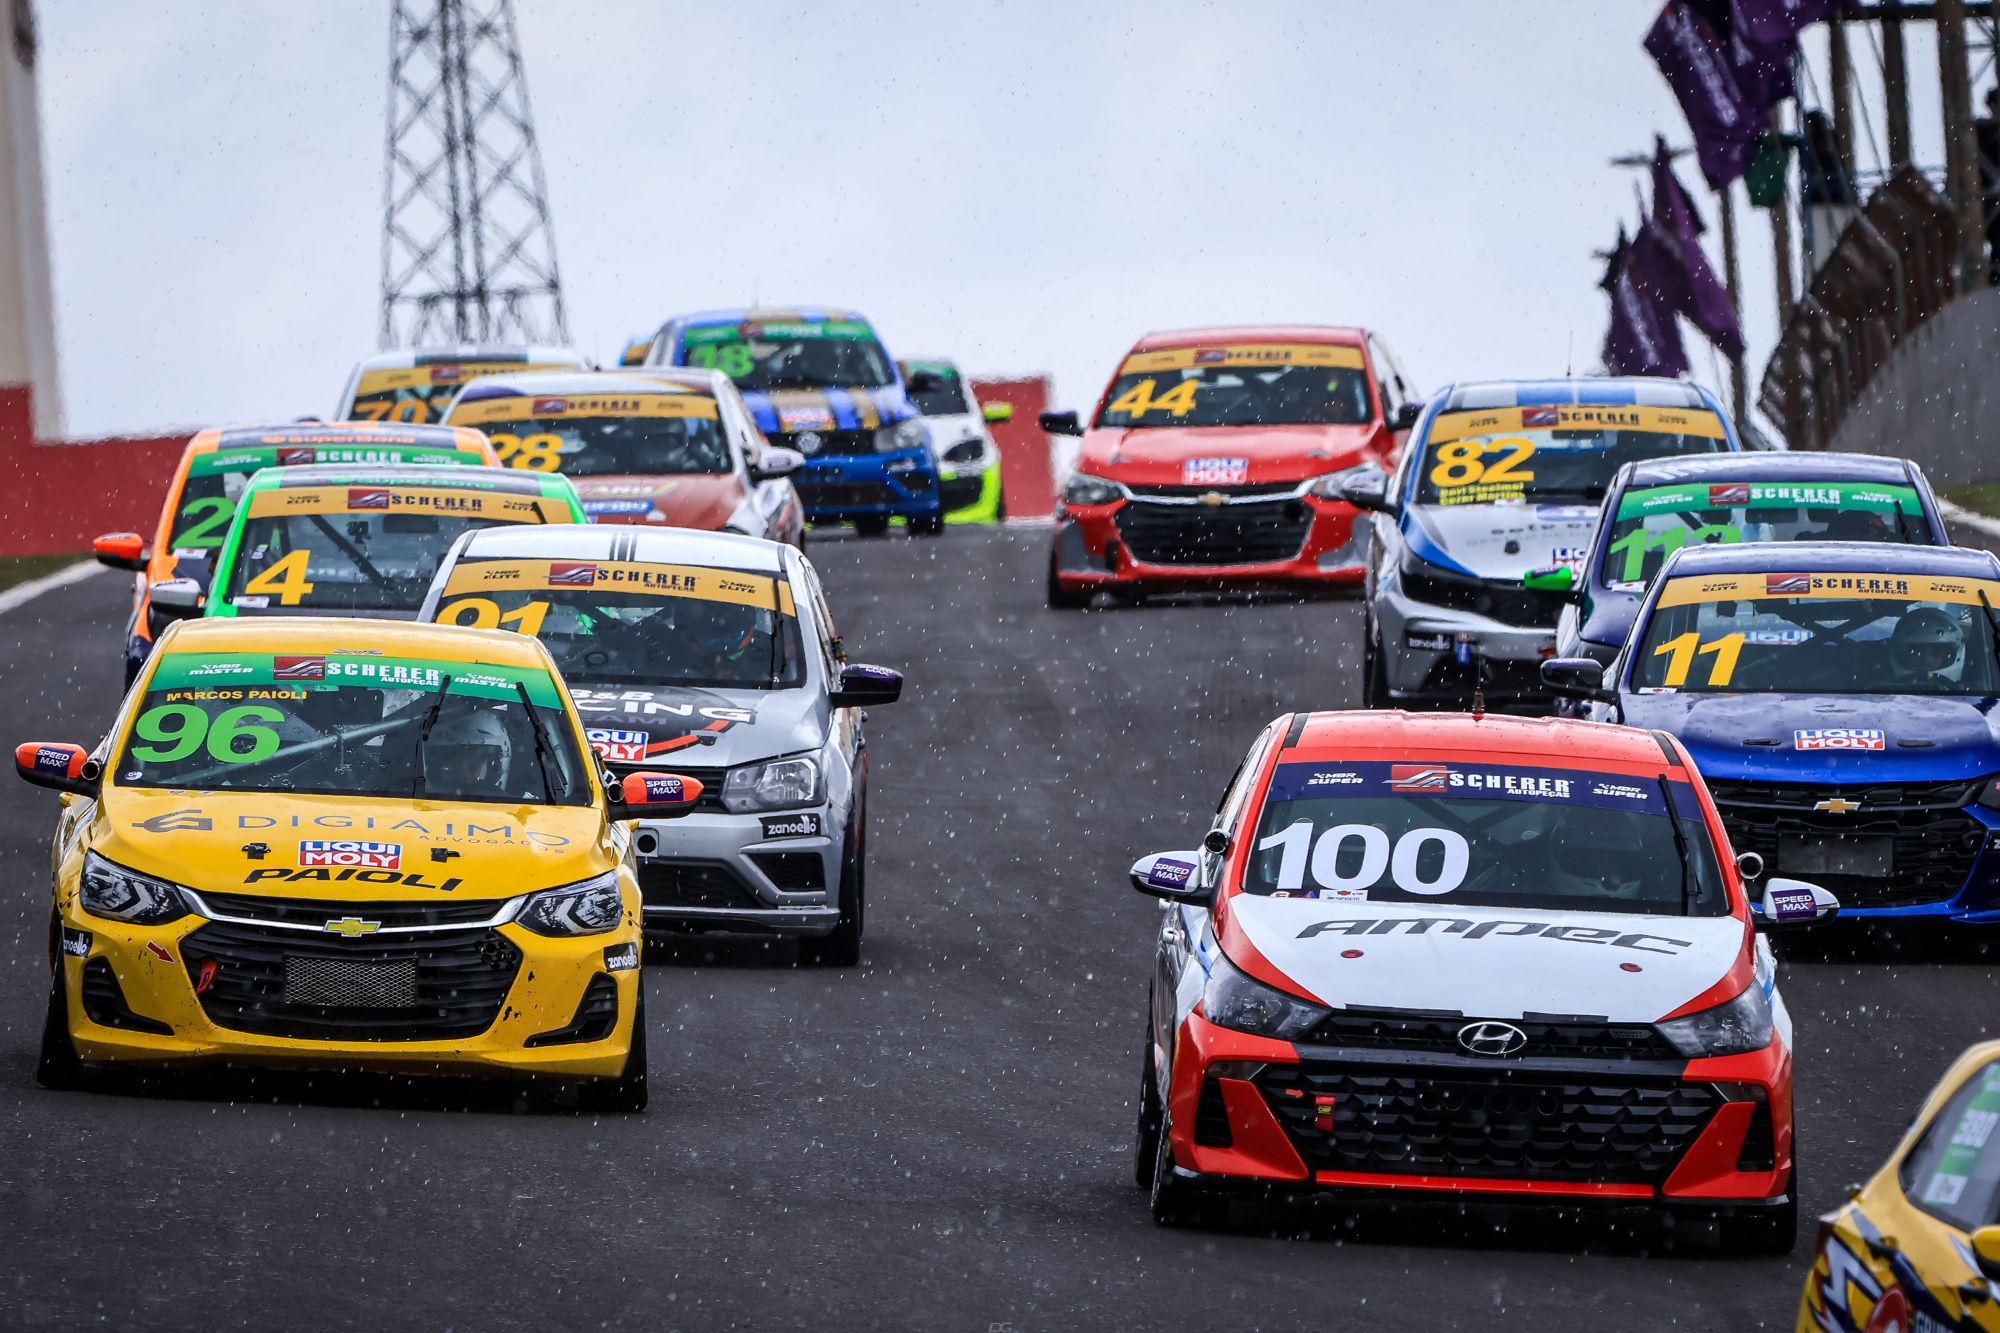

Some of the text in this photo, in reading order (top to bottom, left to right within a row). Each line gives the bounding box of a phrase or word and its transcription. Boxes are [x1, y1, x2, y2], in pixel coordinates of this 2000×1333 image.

[1109, 379, 1199, 418] 44
[1430, 437, 1536, 488] 82
[1188, 470, 1241, 482] MOLY
[1751, 488, 1841, 500] SCHERER
[391, 495, 482, 508] SCHERER
[244, 549, 314, 606] 4
[597, 570, 696, 588] SCHERER
[718, 585, 756, 594] ELITE
[1812, 578, 1908, 592] SCHERER
[1654, 632, 1745, 686] 11
[189, 668, 253, 676] MASTER
[328, 662, 440, 681] SCHERER
[455, 677, 518, 690] MASTER
[166, 691, 308, 702] MARCOS PAIOLI
[577, 699, 754, 723] CING
[131, 703, 285, 764] 96
[587, 731, 643, 744] QUI
[1800, 730, 1879, 739] LIQUI
[1802, 738, 1883, 750] MOLY
[36, 749, 70, 761] SPEED
[591, 743, 645, 760] OLY
[40, 757, 63, 768] MAX
[646, 780, 681, 788] SPEED
[1307, 777, 1364, 786] SUPER
[1450, 773, 1571, 793] SCHERER
[653, 787, 677, 795] MAX
[1592, 789, 1648, 799] SUPER
[238, 815, 570, 846] DIGIAIMO
[768, 815, 817, 835] zanoello
[305, 841, 400, 855] LIQUI
[419, 835, 565, 854] ADVOGADOS
[305, 851, 400, 868] MOLY
[1259, 822, 1470, 895] 100
[1153, 863, 1190, 875] SPEED
[1156, 870, 1180, 881] MAX
[243, 868, 464, 892] PAIOLI
[1774, 894, 1812, 904] SPEED
[1782, 902, 1810, 911] MAX
